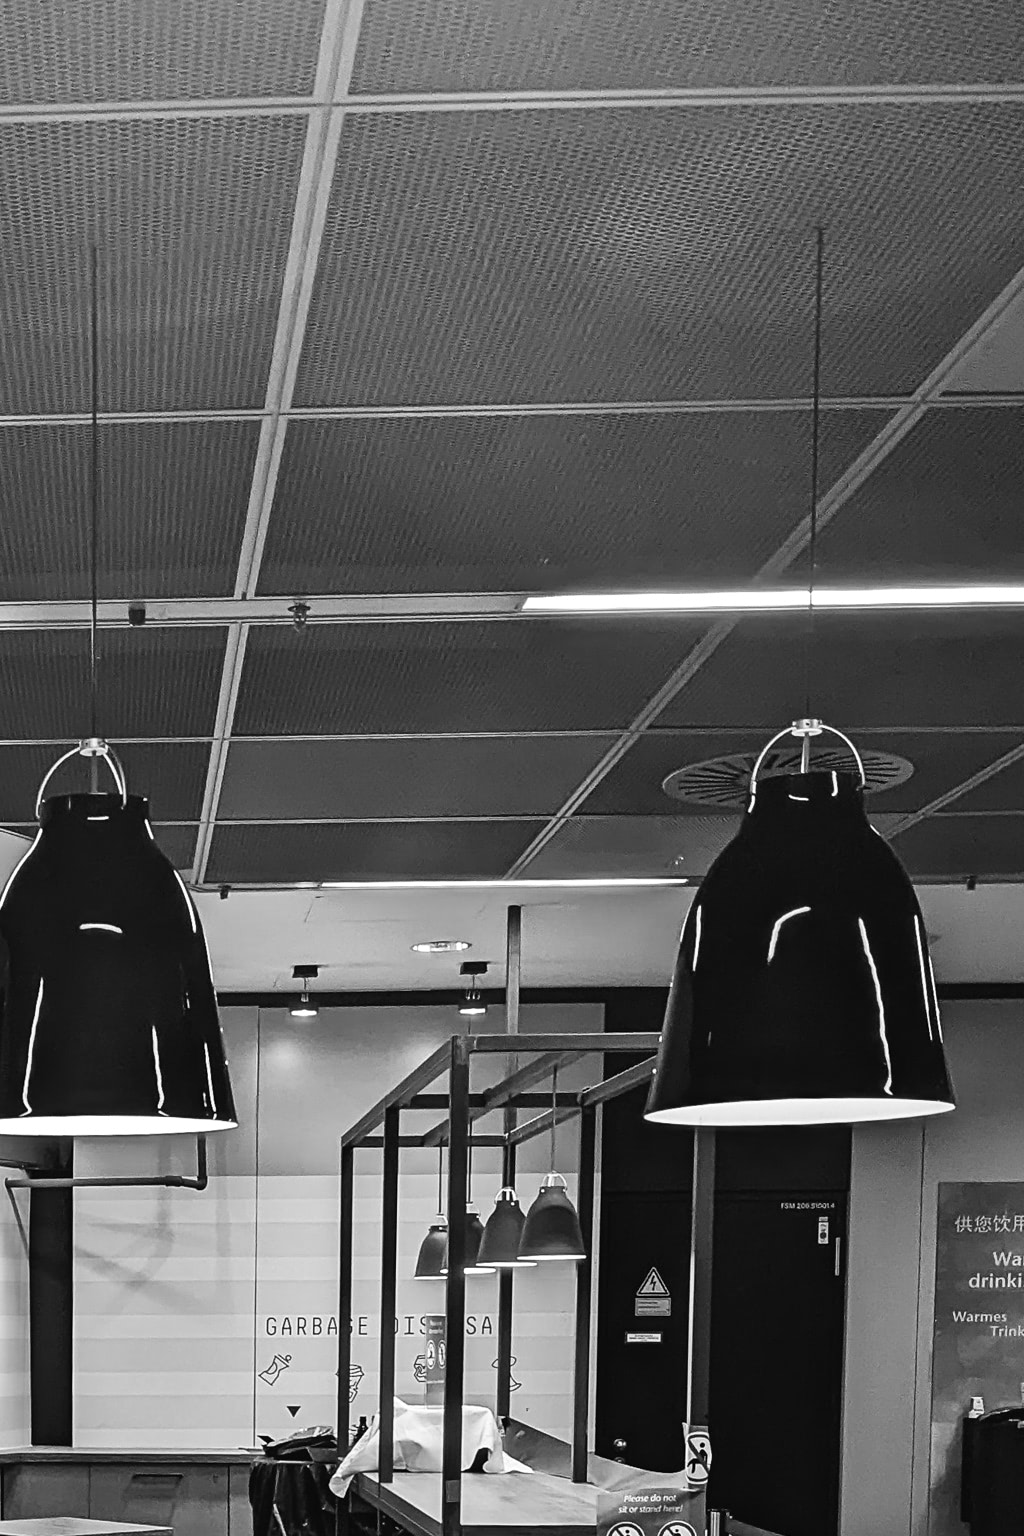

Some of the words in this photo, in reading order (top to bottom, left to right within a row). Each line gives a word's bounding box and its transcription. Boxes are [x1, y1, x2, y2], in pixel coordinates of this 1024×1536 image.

[993, 1251, 1024, 1266] Wa
[968, 1272, 1024, 1288] drinki
[953, 1311, 1007, 1322] Warmes
[650, 1494, 661, 1502] do
[618, 1506, 628, 1514] sit
[640, 1505, 661, 1513] stand
